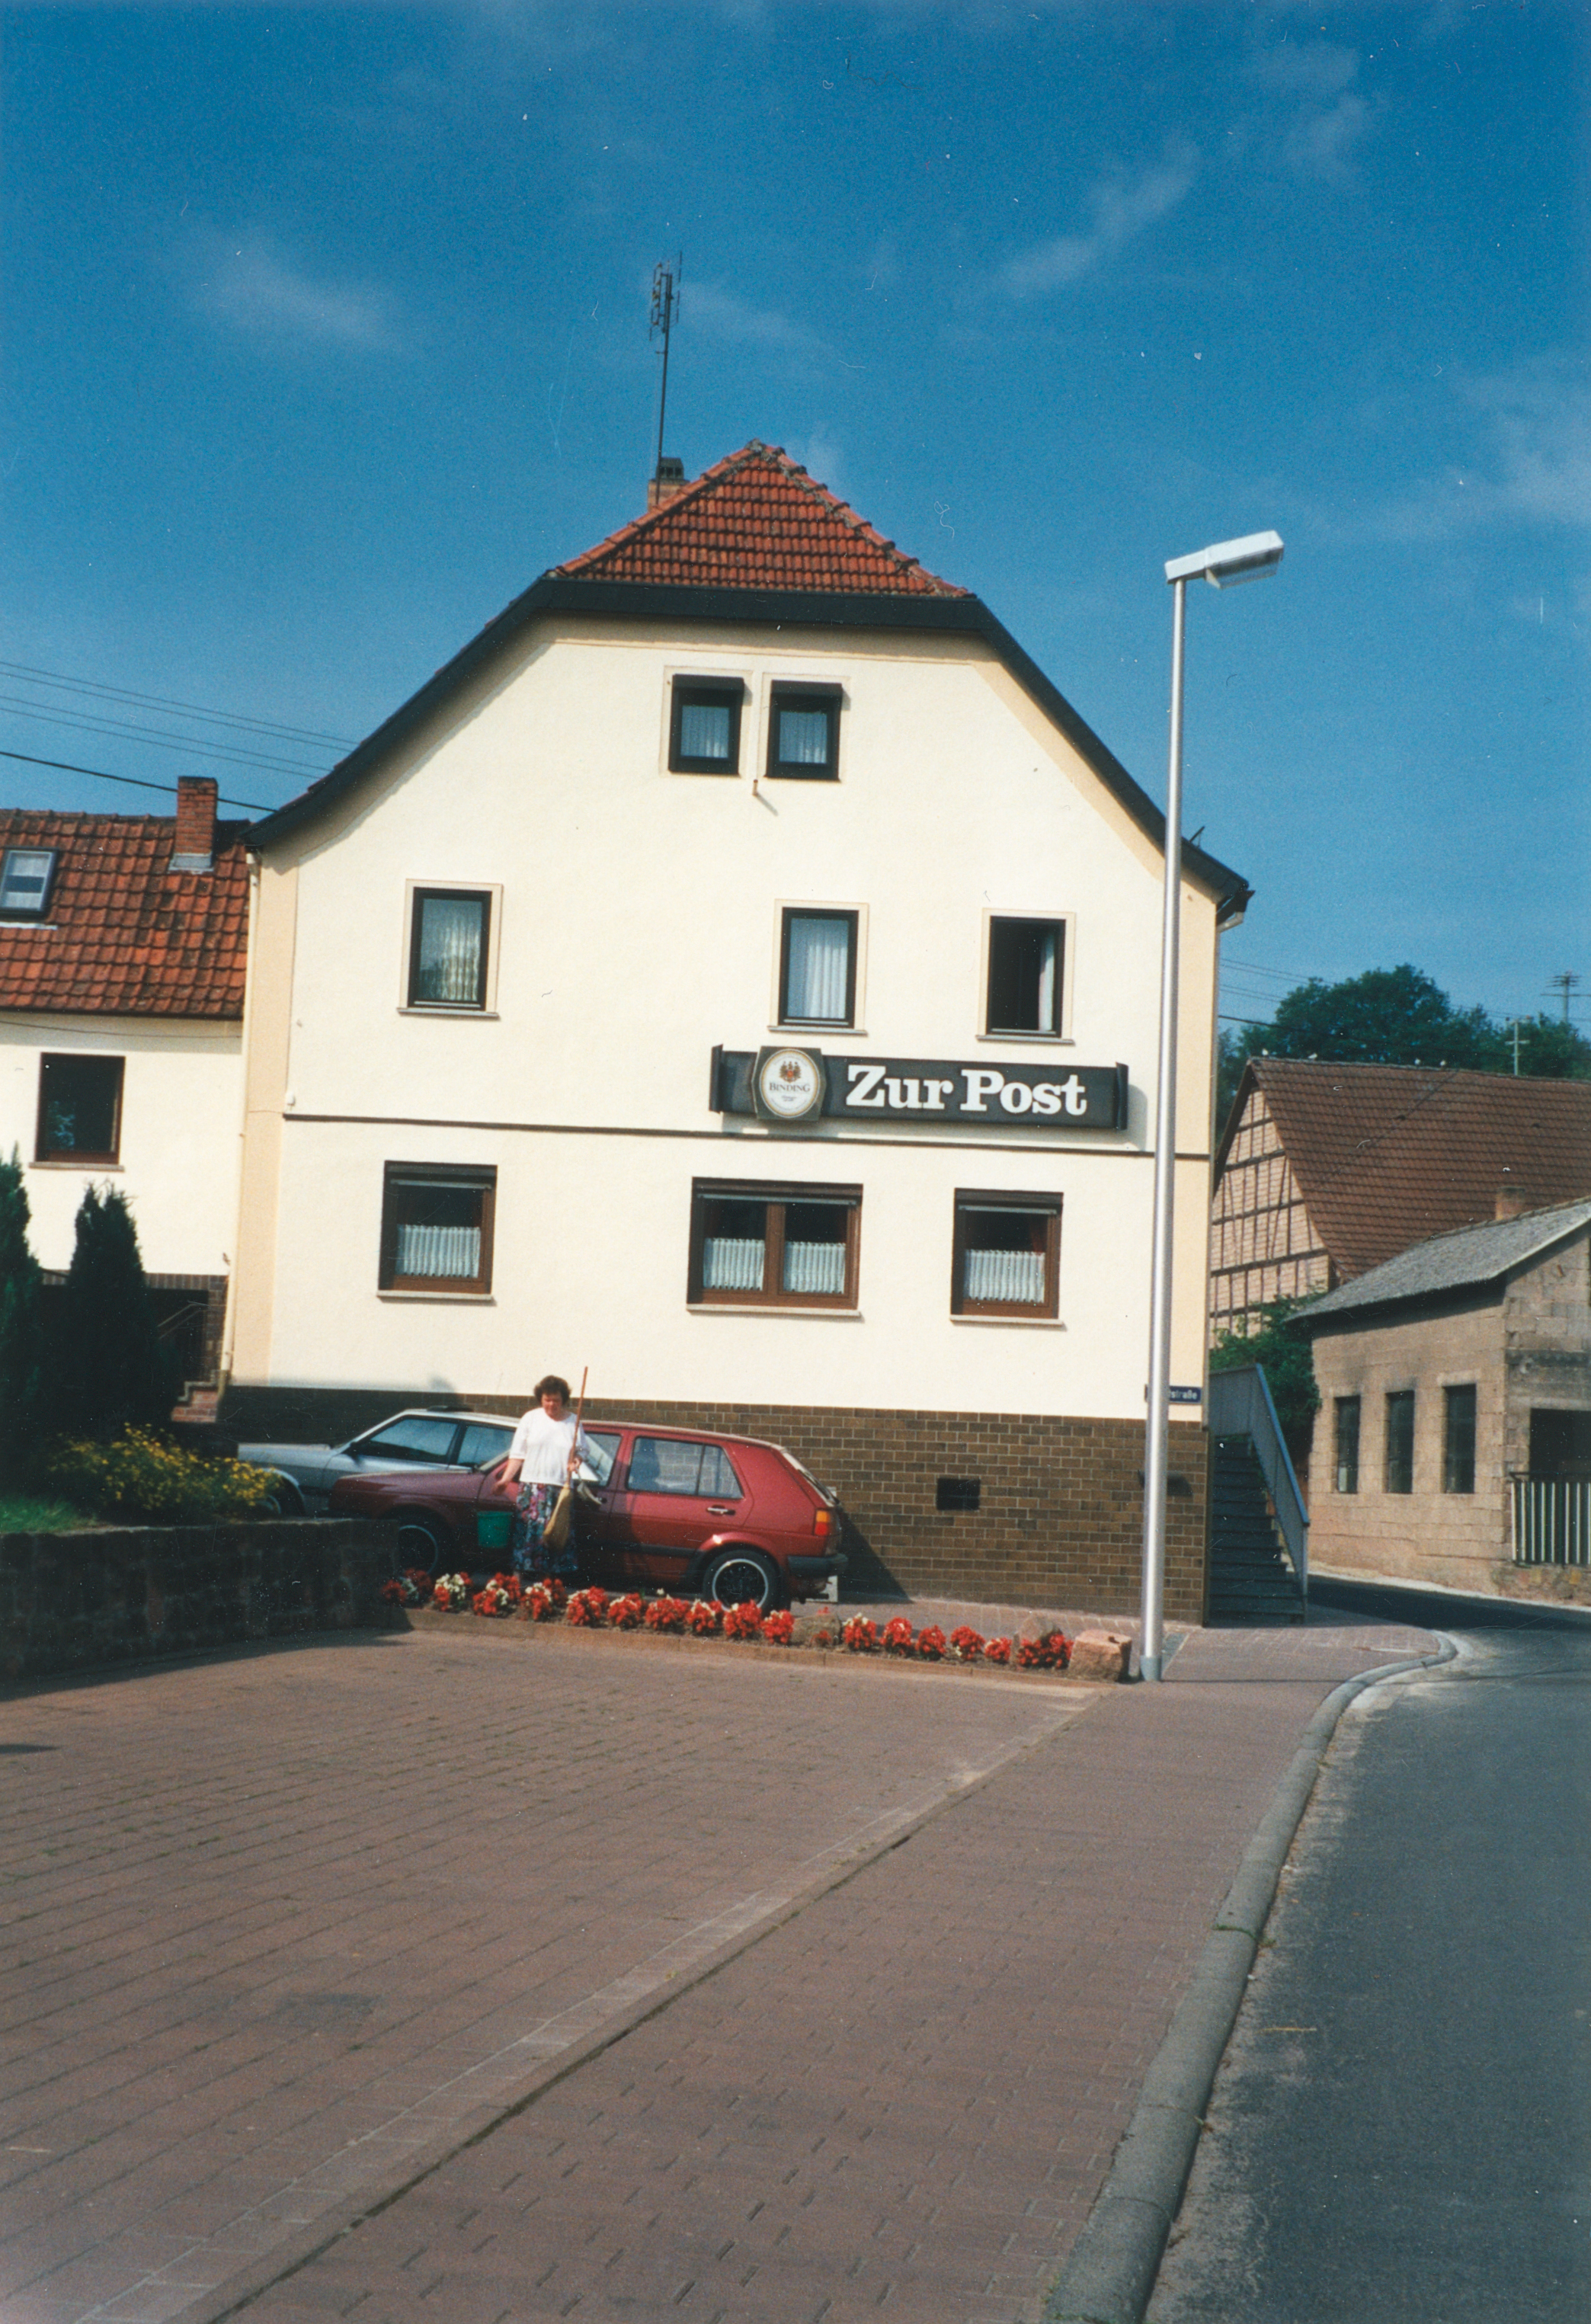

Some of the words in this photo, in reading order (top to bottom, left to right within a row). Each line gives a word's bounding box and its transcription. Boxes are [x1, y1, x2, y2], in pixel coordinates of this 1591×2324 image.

[769, 1082, 811, 1093] BINDING
[846, 1064, 953, 1109] Zur
[960, 1069, 1087, 1116] Post
[1170, 1389, 1198, 1400] straße
